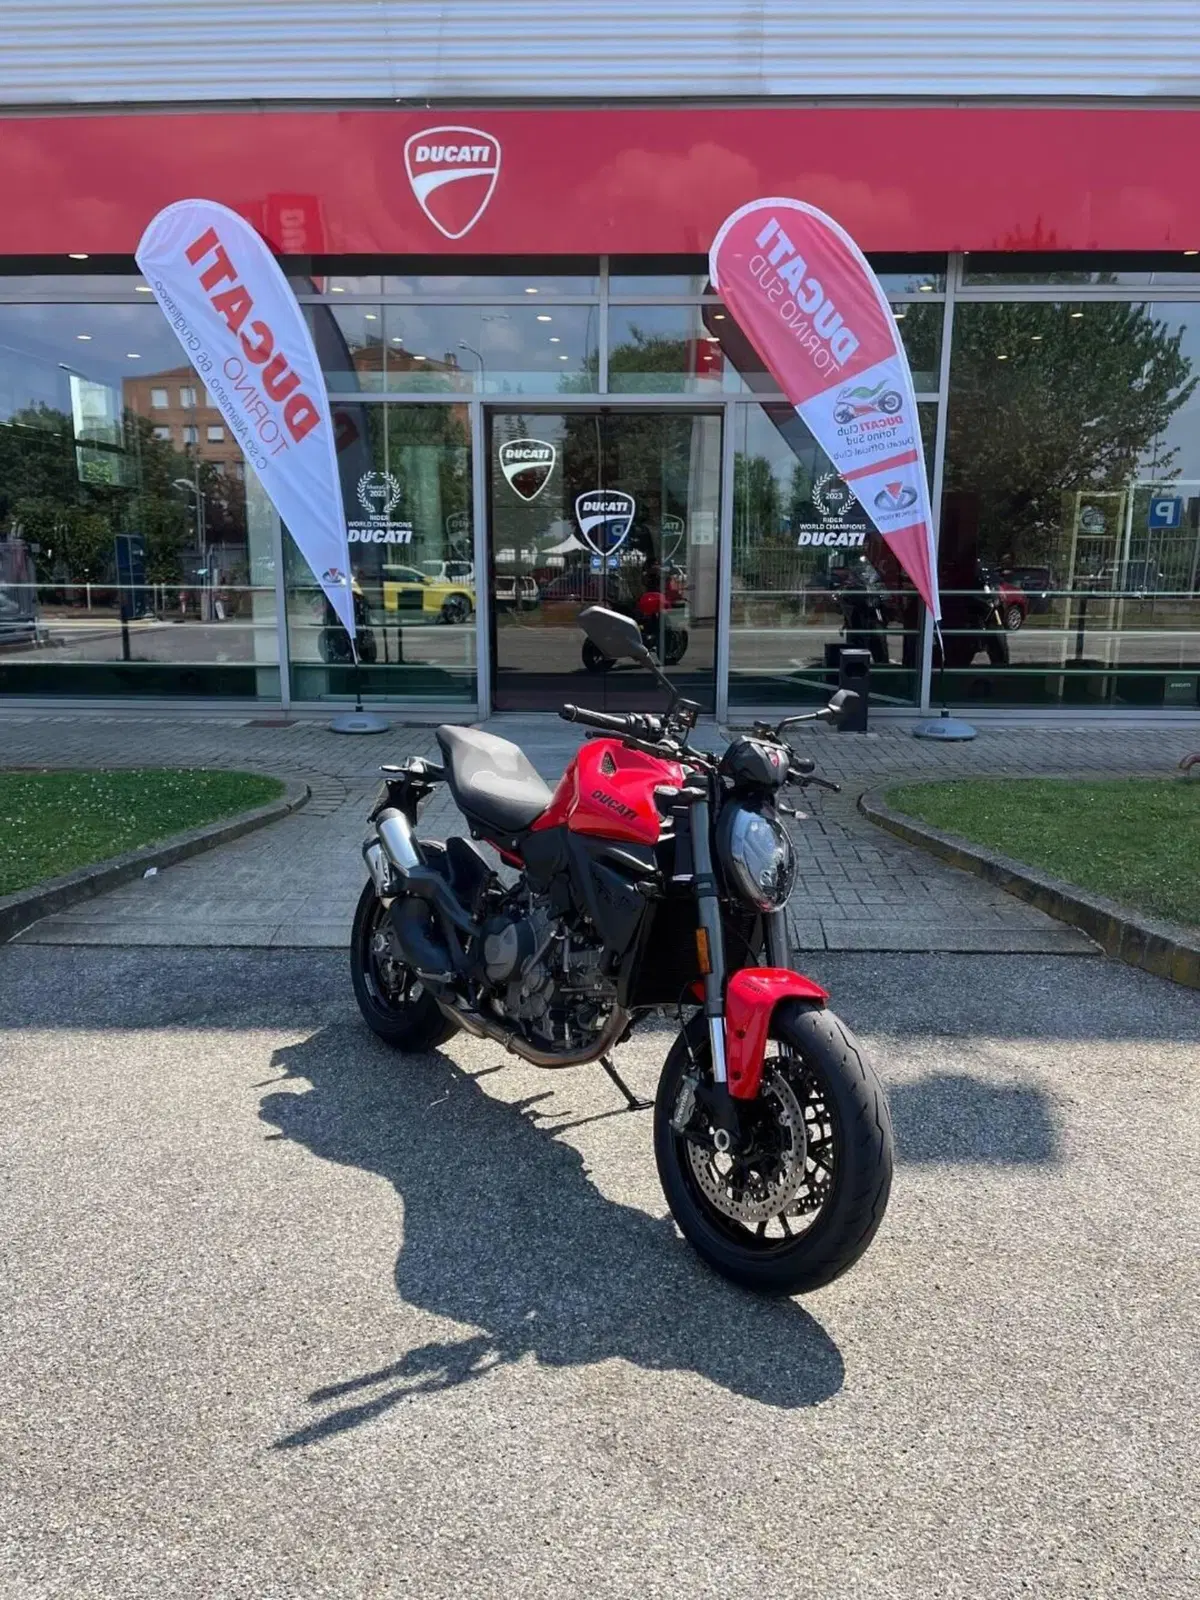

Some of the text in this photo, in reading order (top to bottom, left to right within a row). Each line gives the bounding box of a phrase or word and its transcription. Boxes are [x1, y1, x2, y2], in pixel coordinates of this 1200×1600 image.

[415, 145, 490, 162] DUCATI
[505, 449, 550, 459] DUCATI
[825, 492, 843, 500] 2023
[582, 501, 628, 512] DUCATI
[347, 529, 412, 543] DUCATI
[798, 532, 866, 546] DUCATI
[591, 789, 639, 821] DUCATI
